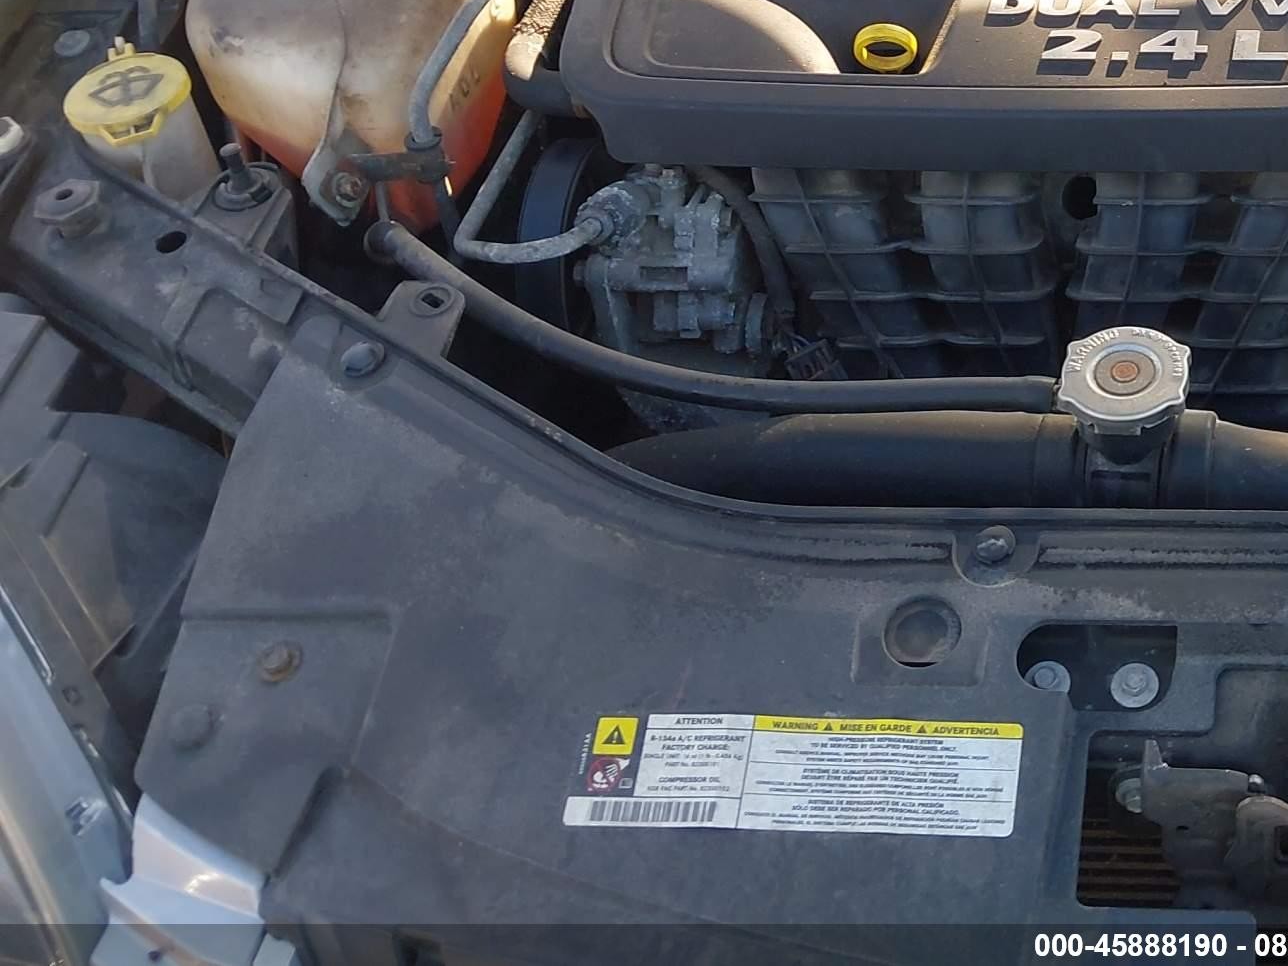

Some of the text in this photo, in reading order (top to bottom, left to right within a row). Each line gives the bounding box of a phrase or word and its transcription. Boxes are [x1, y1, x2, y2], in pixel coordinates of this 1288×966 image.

[1065, 329, 1120, 372] WARNING
[675, 717, 723, 725] ATTENTION
[772, 720, 819, 730] WARNING
[840, 723, 912, 732] MISE EN GARDE
[932, 725, 1000, 735] ADVERTENCIA
